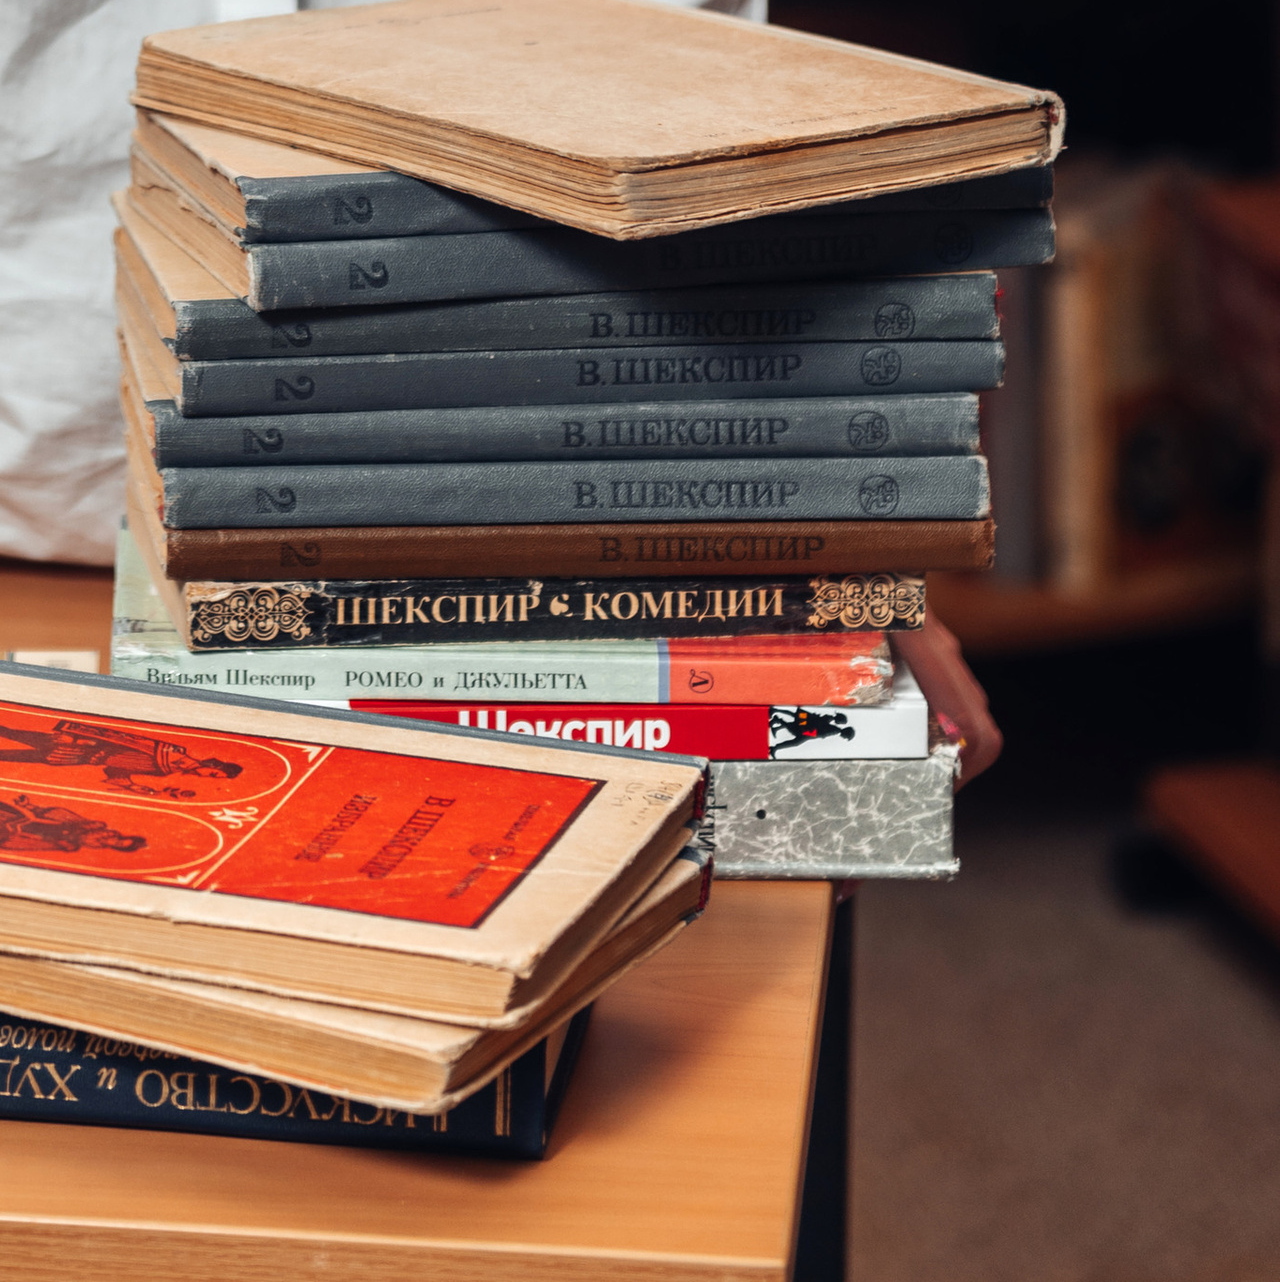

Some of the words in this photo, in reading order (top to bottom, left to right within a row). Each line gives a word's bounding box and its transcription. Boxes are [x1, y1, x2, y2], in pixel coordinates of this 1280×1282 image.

[335, 591, 540, 628] ШЕКСПИР
[583, 588, 784, 623] КОМЕДИИ
[147, 668, 218, 686] Вильям
[226, 669, 316, 691] Шекспир
[344, 671, 424, 688] РОМЕО
[433, 676, 445, 688] и
[453, 669, 588, 694] ДЖУЛЬЕТТА
[97, 1066, 118, 1090] и
